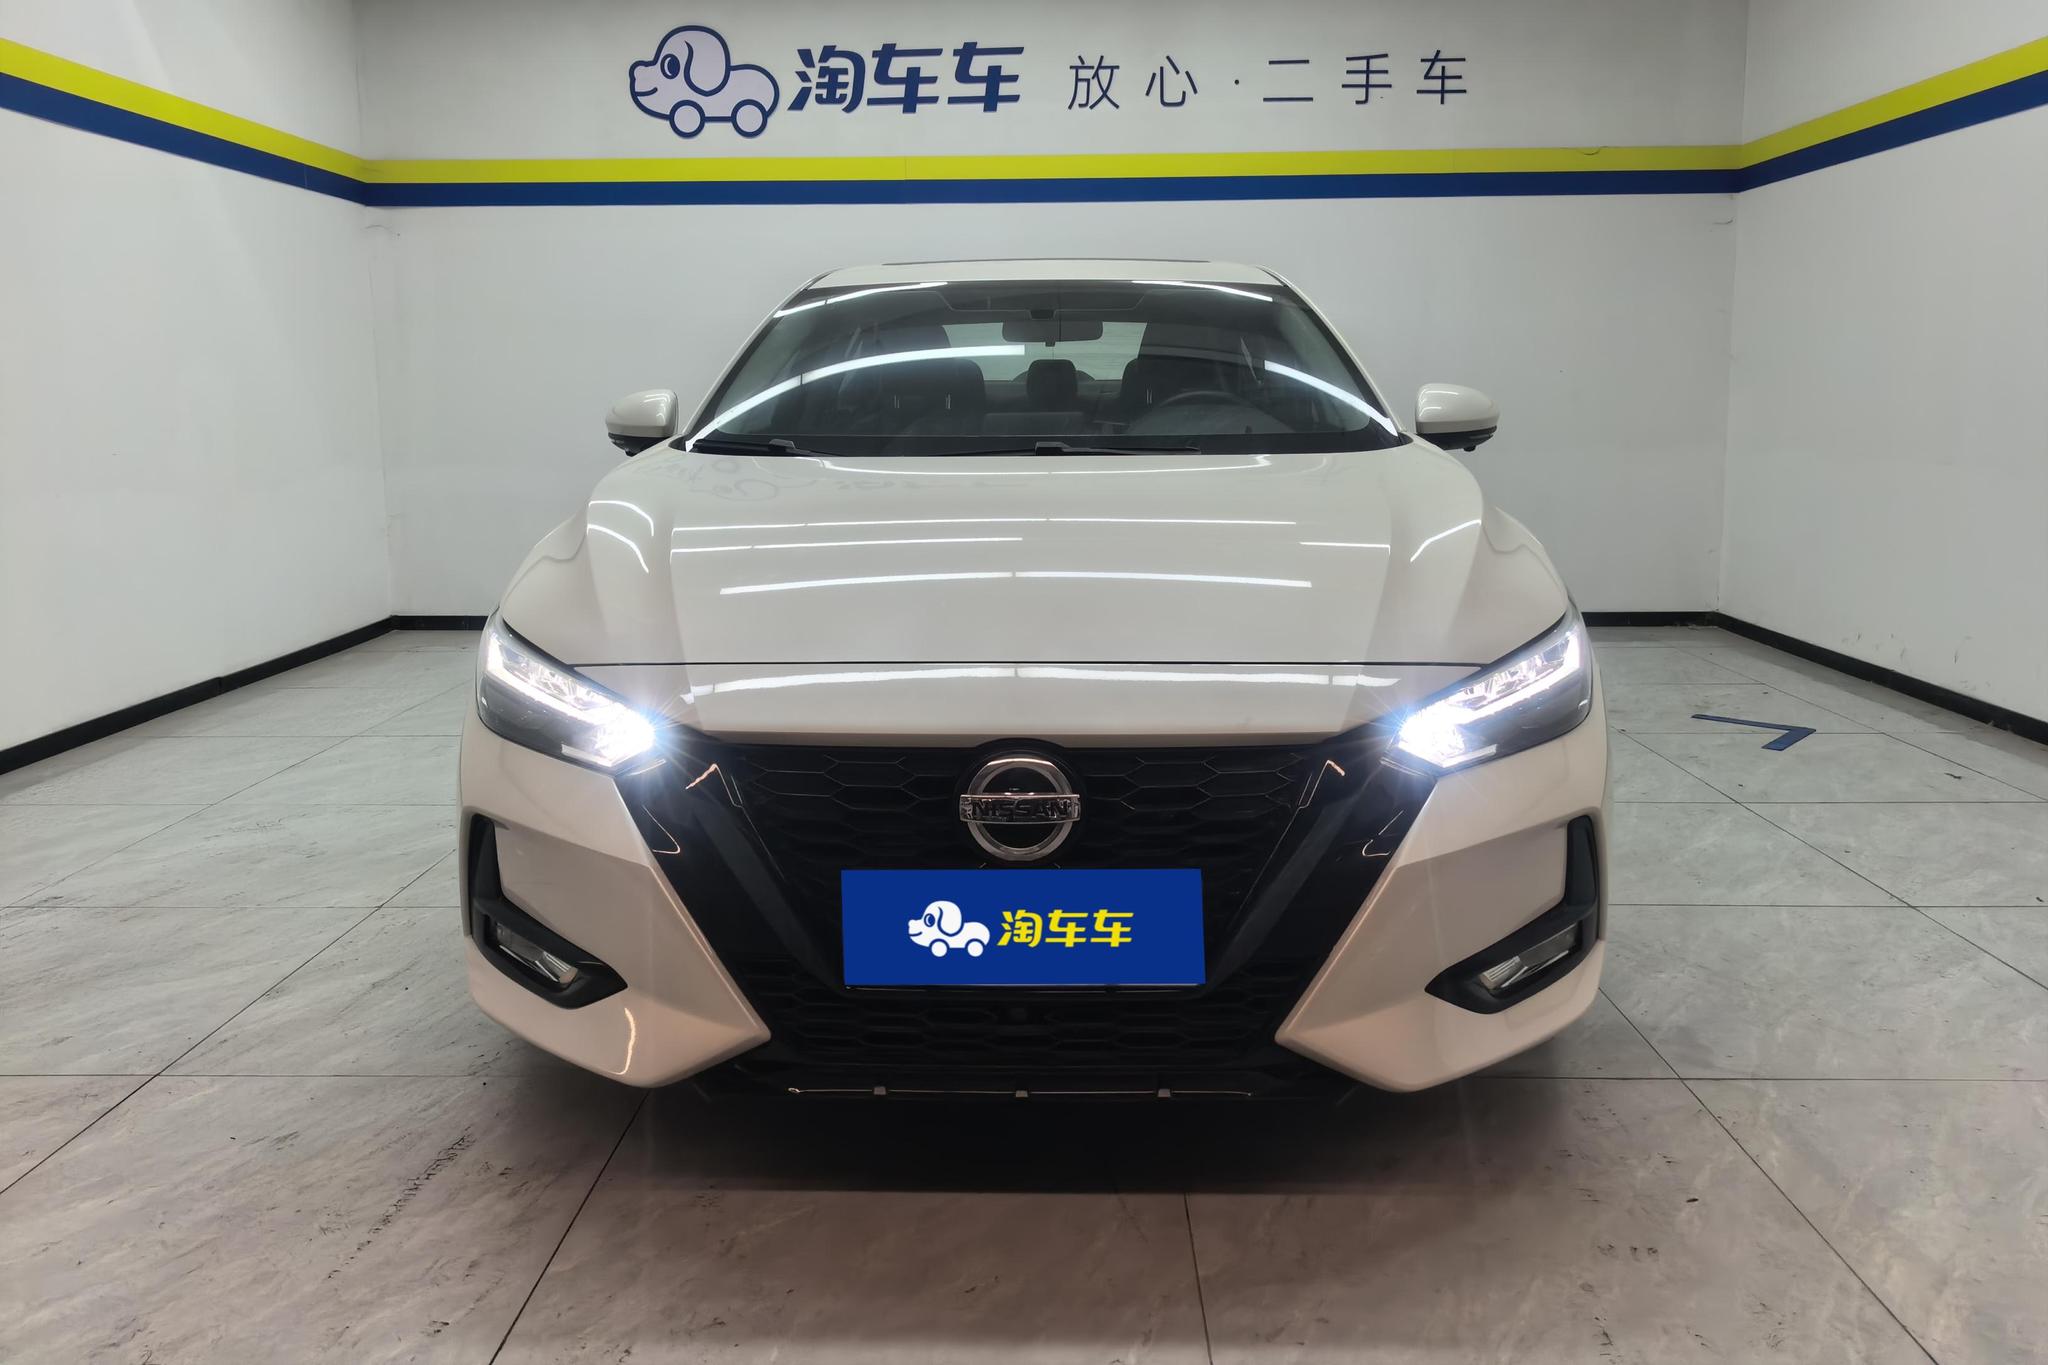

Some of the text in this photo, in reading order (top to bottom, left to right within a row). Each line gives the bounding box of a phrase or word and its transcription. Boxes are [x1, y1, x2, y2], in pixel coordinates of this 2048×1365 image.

[787, 42, 1025, 114] 淘车车
[972, 798, 1074, 819] NISSAN
